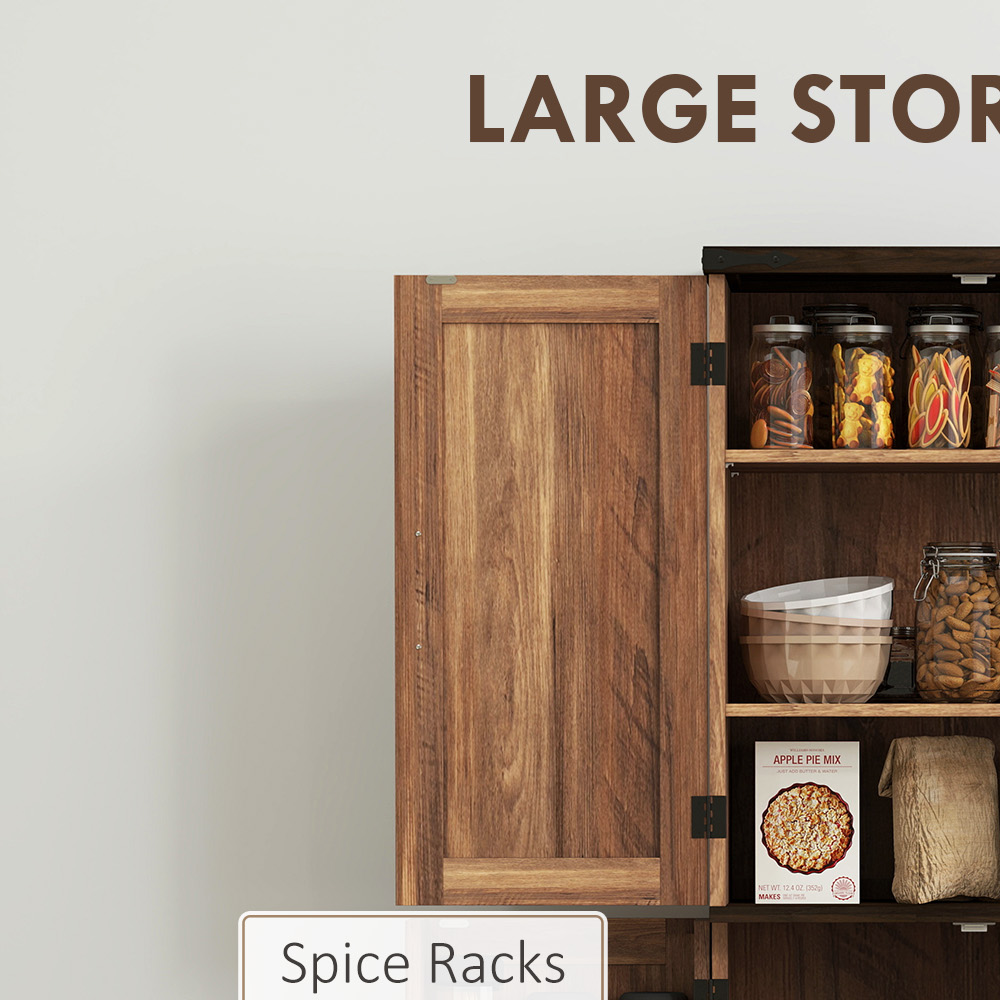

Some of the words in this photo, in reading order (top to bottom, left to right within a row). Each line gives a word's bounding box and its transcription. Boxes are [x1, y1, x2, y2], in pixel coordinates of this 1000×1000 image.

[773, 755, 803, 765] APPLE
[806, 755, 820, 765] PIE
[823, 755, 841, 765] MIX
